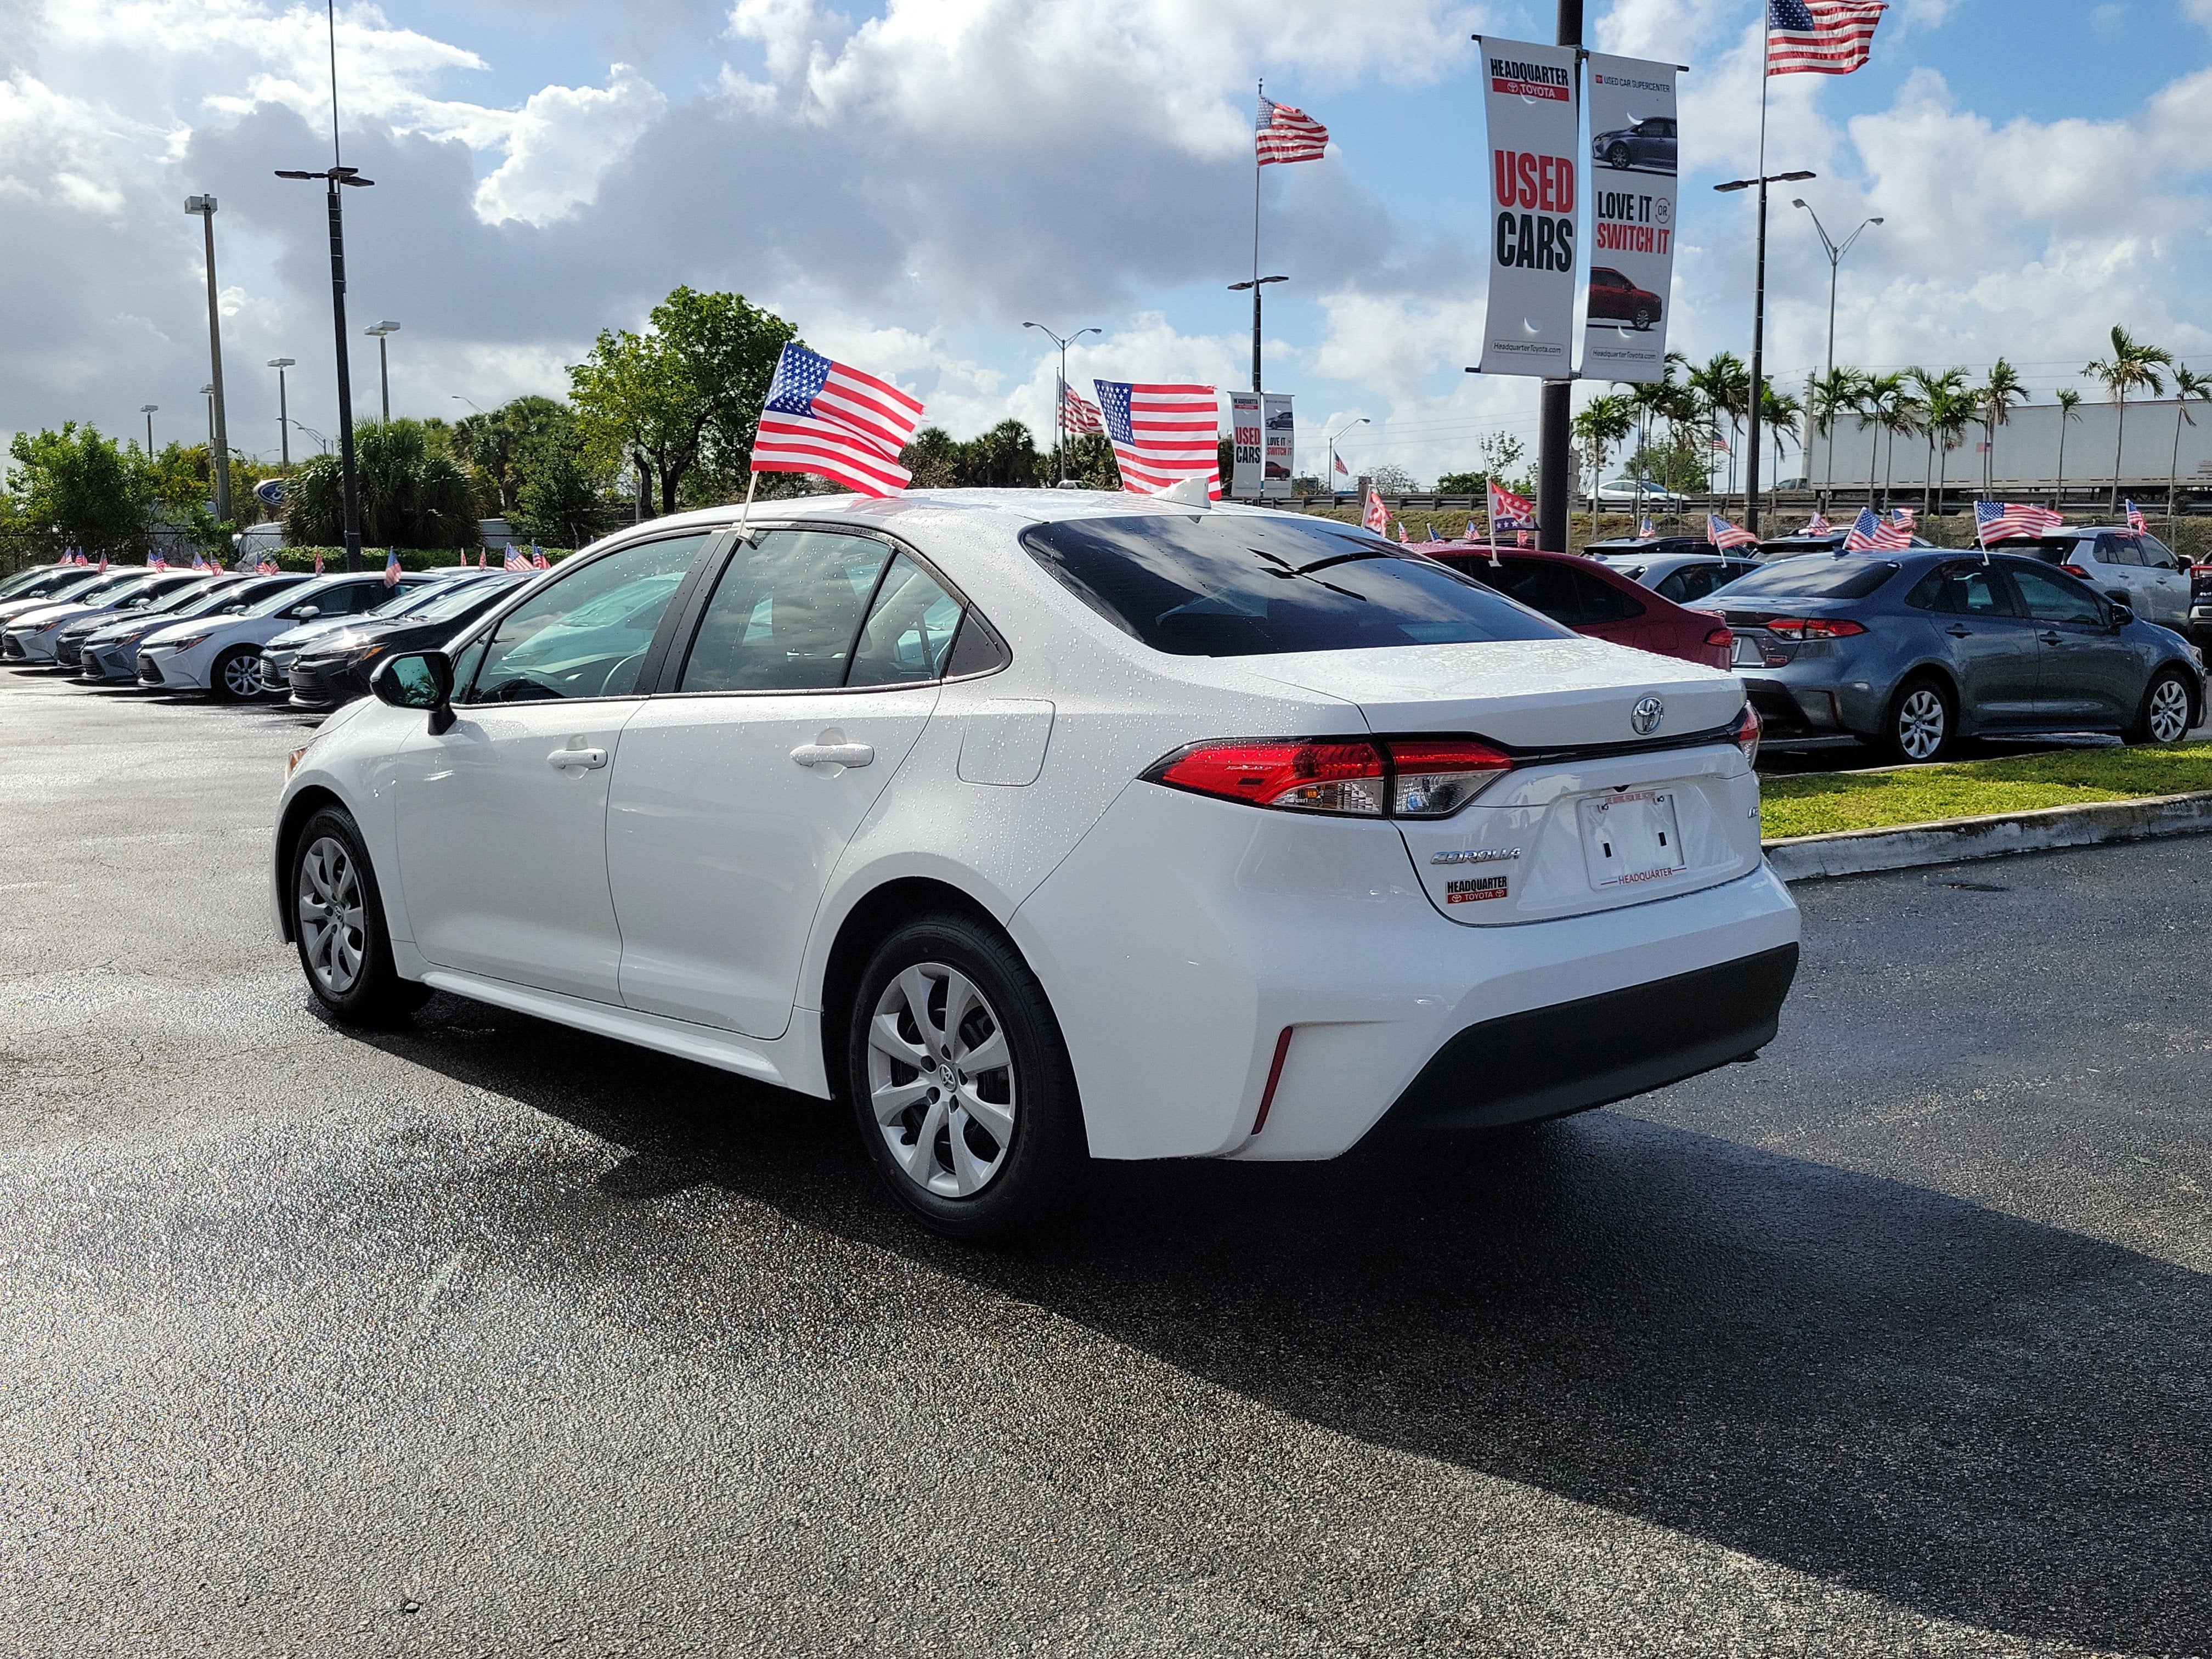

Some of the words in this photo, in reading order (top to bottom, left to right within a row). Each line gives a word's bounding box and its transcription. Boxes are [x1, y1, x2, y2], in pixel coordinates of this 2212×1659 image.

[1490, 58, 1568, 86] HEADQUARTER
[1520, 83, 1556, 99] TOYOTA
[1604, 76, 1618, 86] USED
[1620, 78, 1631, 88] CAR
[1632, 80, 1670, 93] SUPERCENTER
[1494, 149, 1573, 213] USED
[1598, 191, 1634, 221] LOVE
[1638, 195, 1652, 223] IT
[1657, 205, 1668, 216] OR
[1497, 211, 1573, 272] CARS
[1596, 222, 1654, 253] SWITCH
[1657, 228, 1670, 255] IT
[1493, 342, 1561, 354] HeadquarterToyota.com
[1235, 426, 1260, 445] USED
[1267, 437, 1279, 446] LOVE
[1281, 437, 1285, 446] IT
[1236, 446, 1260, 464] CARS
[1288, 448, 1292, 456] IT
[1430, 847, 1521, 865] COROLLA
[1447, 876, 1507, 893] HEADQUARTER
[1618, 867, 1673, 885] HEADQUARTER
[1464, 891, 1493, 901] TOYOTA
